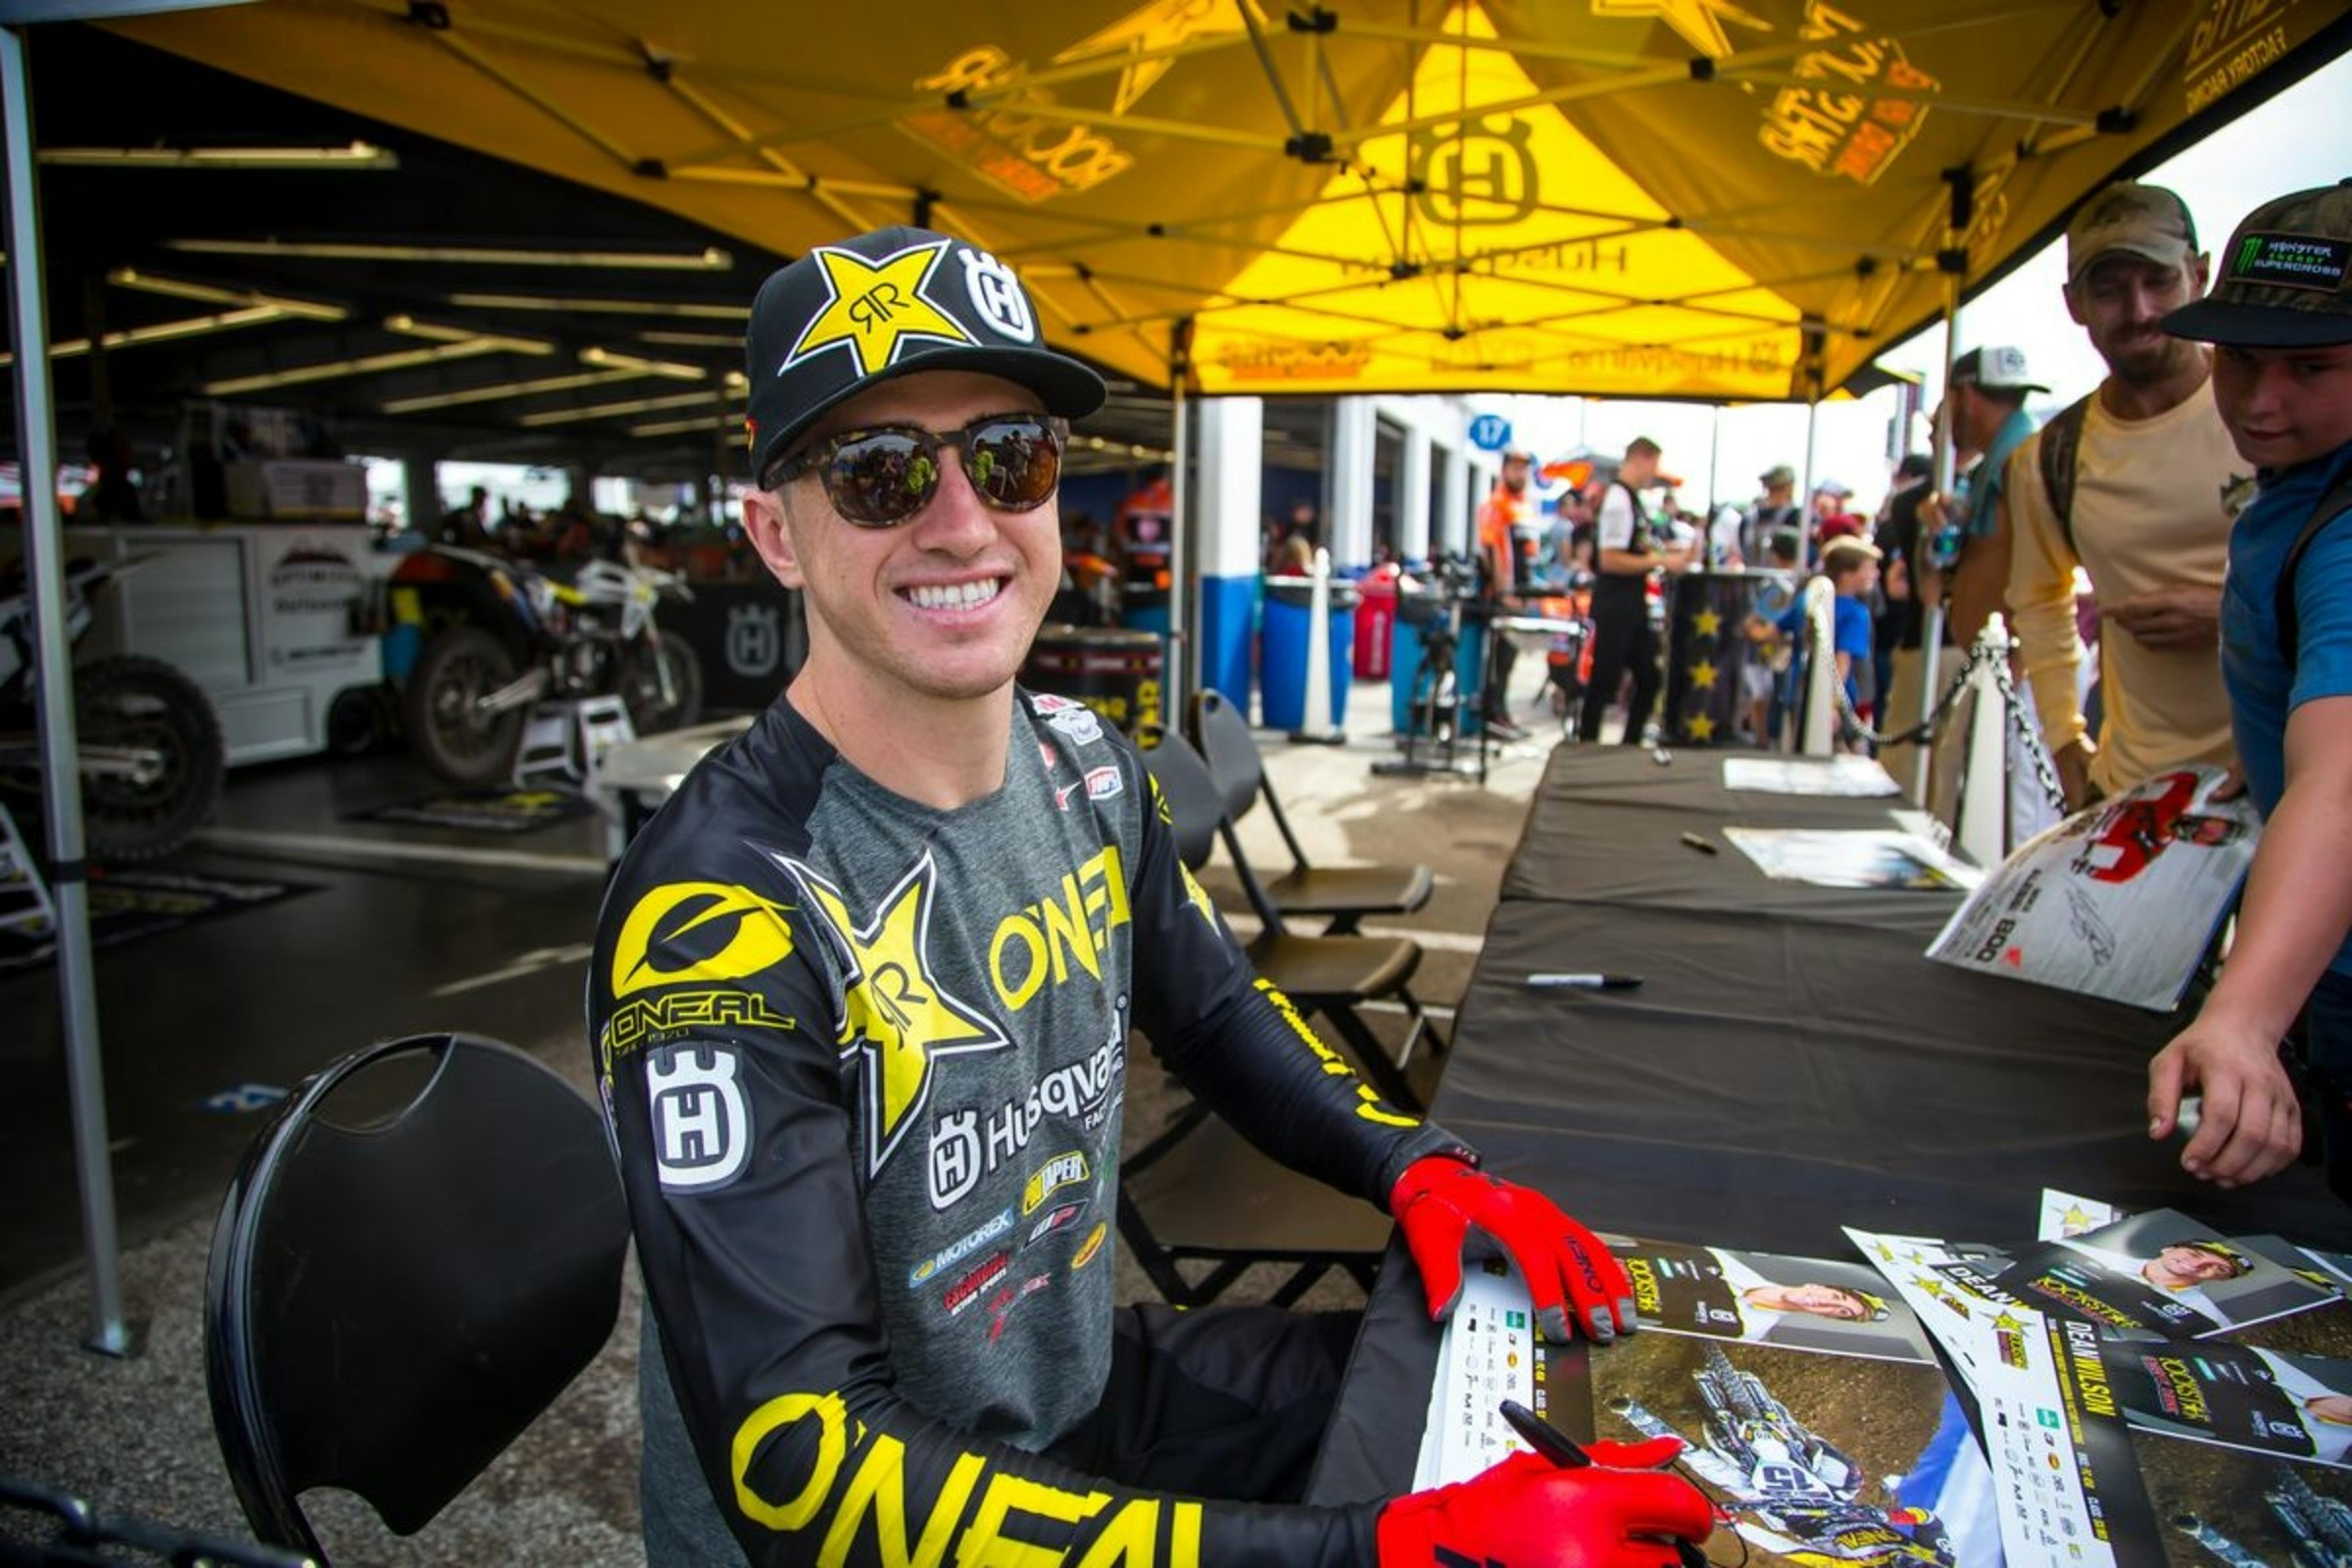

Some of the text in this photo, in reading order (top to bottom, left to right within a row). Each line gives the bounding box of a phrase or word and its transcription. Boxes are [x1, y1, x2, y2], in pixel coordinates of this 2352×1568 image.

[2269, 241, 2331, 257] MONSTER
[2254, 258, 2342, 276] SUPERCROSS
[1479, 416, 1505, 444] 17
[936, 1210, 1010, 1268] MOTOREX
[1947, 1266, 2016, 1304] DEAN
[2064, 1320, 2101, 1359] DEAN
[2074, 1356, 2117, 1416] WILSON
[1763, 1466, 1815, 1491] 15
